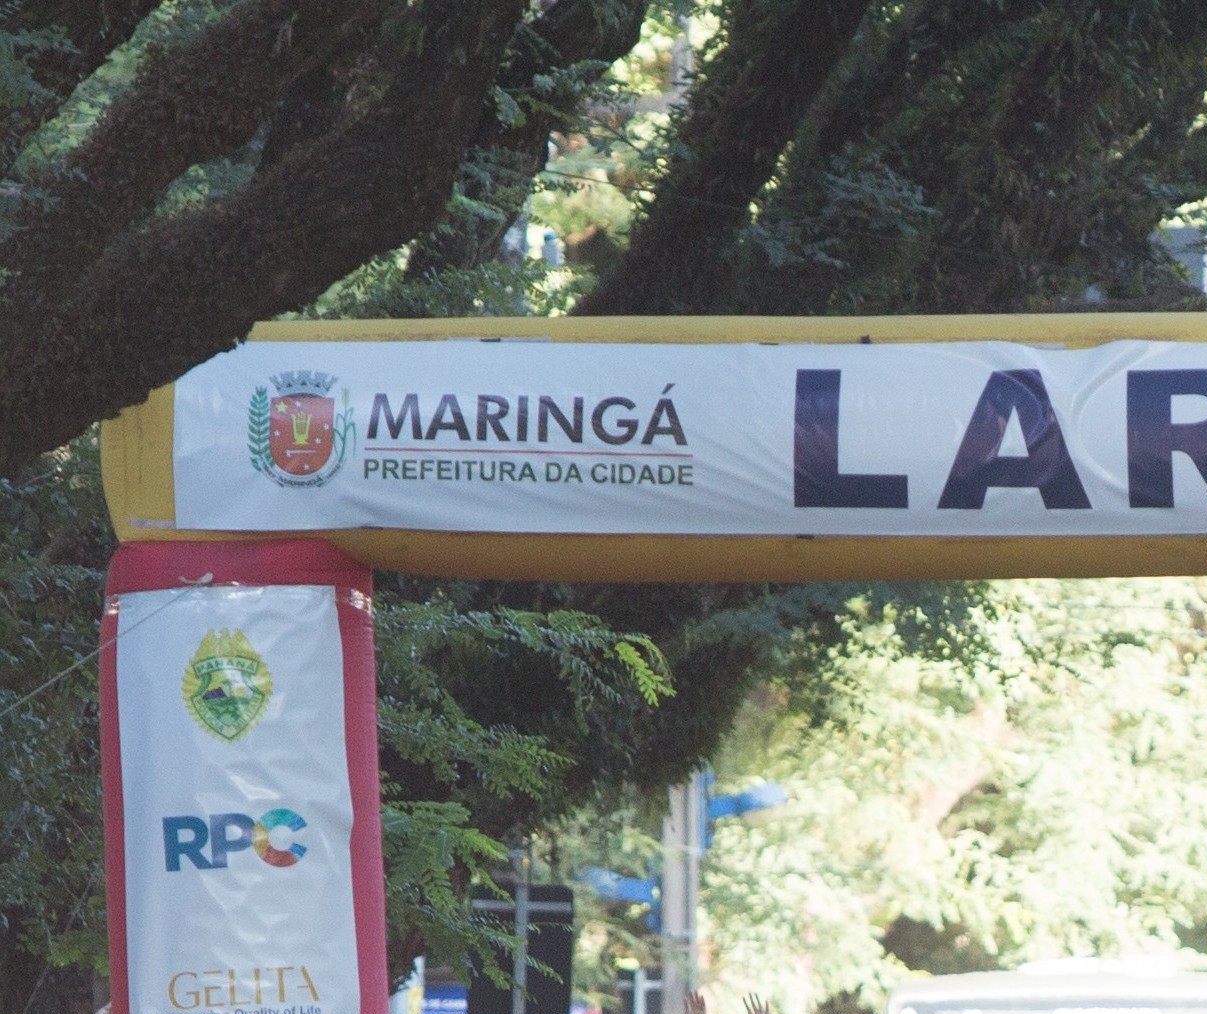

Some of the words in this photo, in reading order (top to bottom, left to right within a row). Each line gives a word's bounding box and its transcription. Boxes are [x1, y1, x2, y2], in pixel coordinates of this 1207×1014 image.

[366, 384, 688, 447] MARINGÁ
[364, 459, 539, 484] PREFEITURA
[544, 461, 584, 484] DA
[590, 463, 694, 486] CIDADE
[162, 808, 307, 872] RPC
[168, 965, 320, 1010] GELITA
